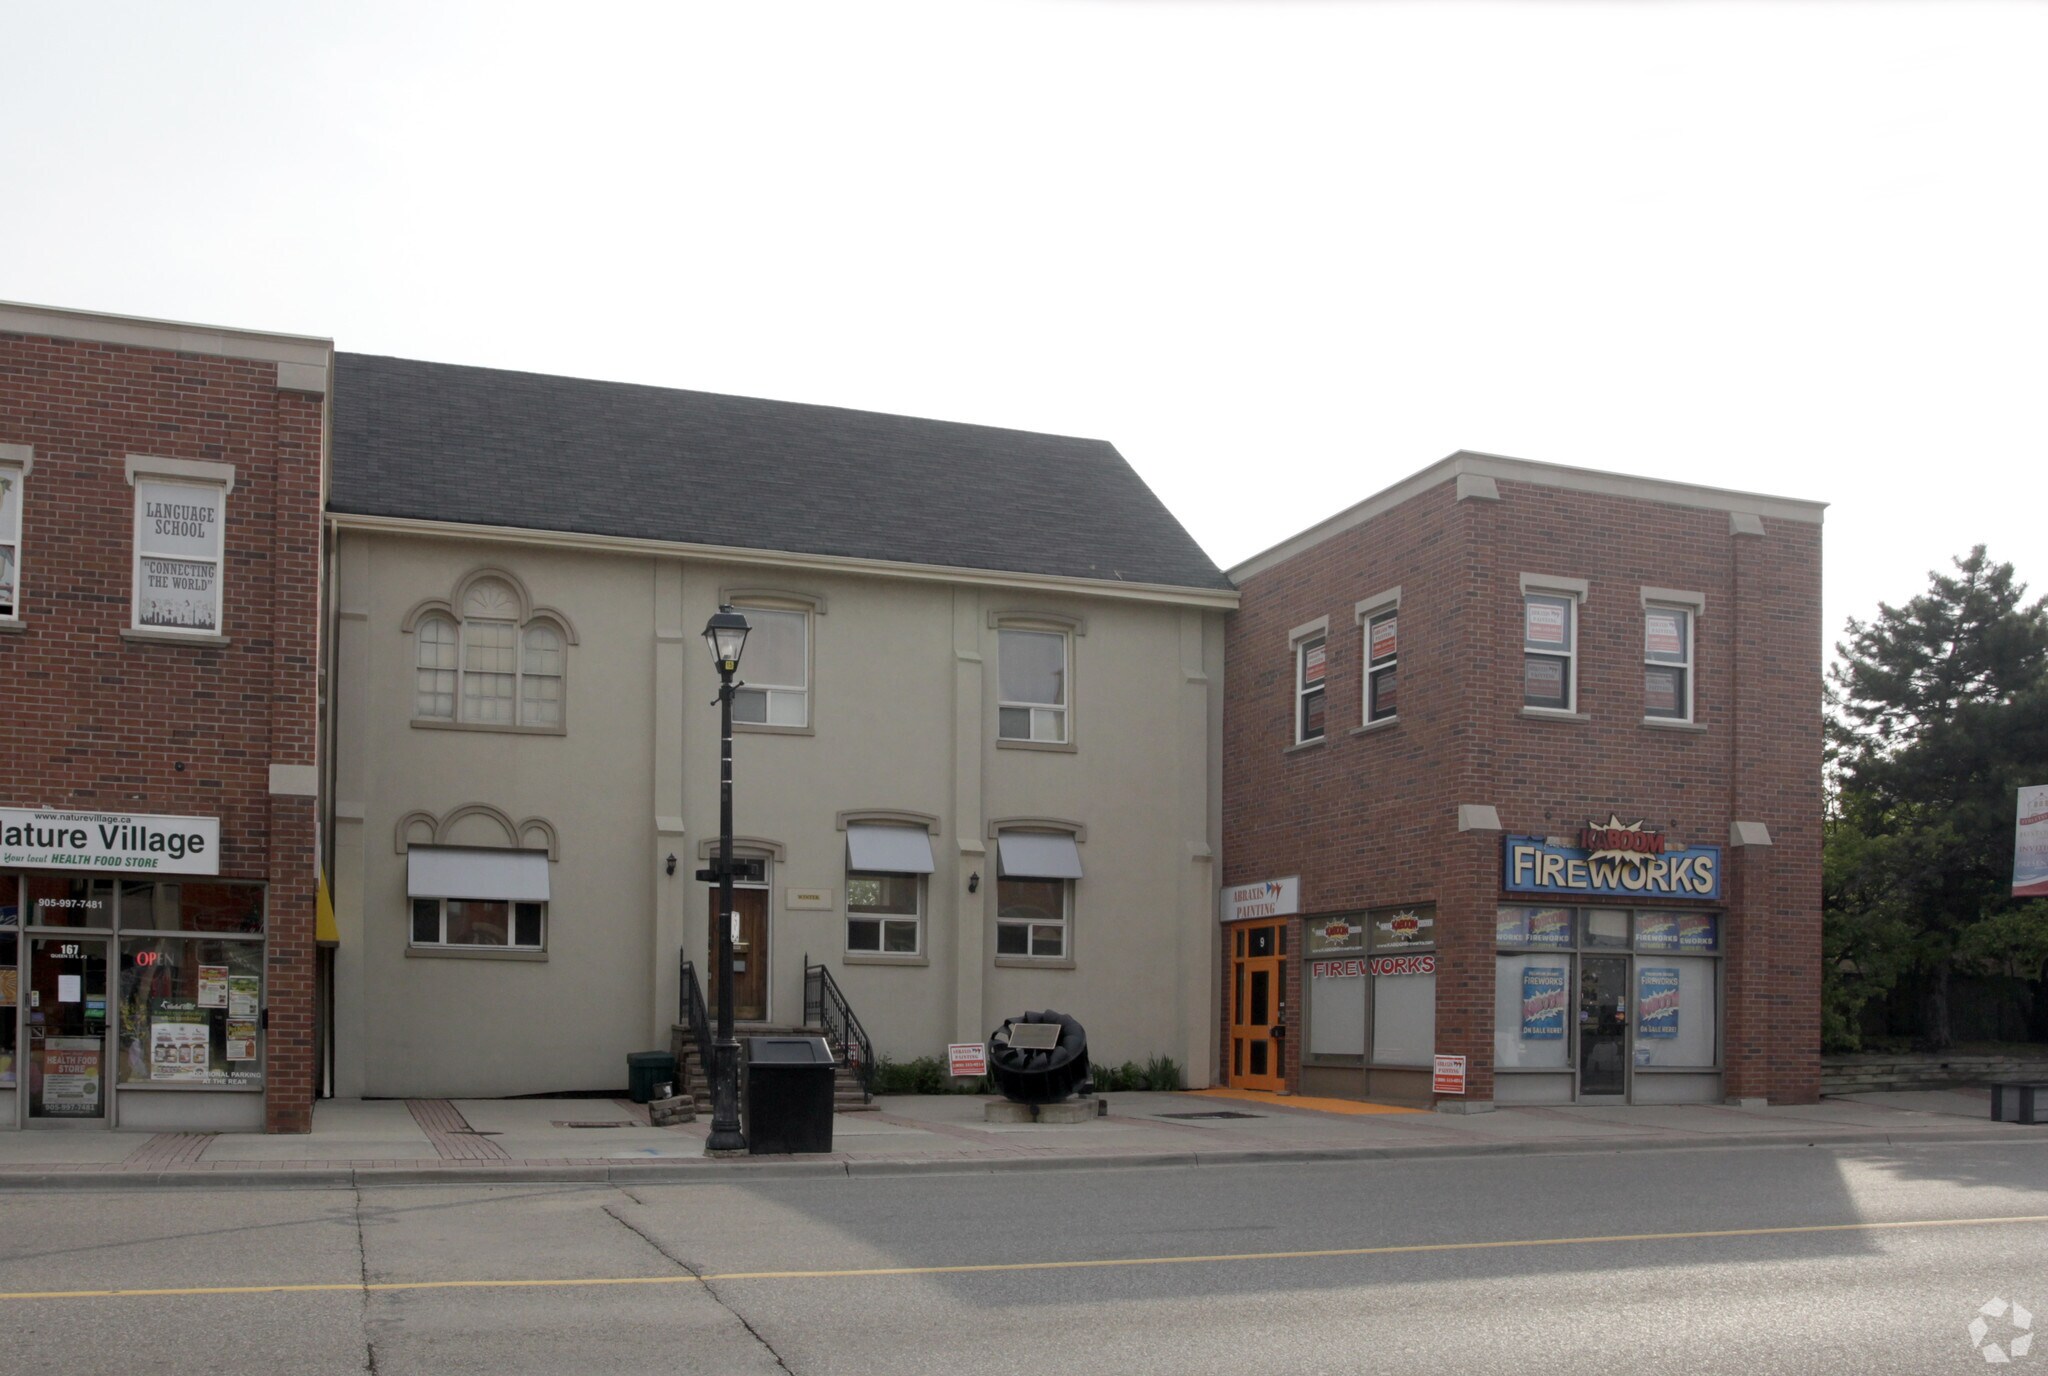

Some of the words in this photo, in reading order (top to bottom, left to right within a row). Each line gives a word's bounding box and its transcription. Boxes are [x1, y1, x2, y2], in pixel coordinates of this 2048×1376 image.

[146, 502, 214, 523] LANGUAGE
[155, 519, 205, 538] SCHOOL
[148, 574, 168, 589] THE
[34, 813, 131, 824] www.naturevillage.ca
[0, 821, 87, 849] ature
[98, 824, 205, 859] Village
[1580, 828, 1665, 854] KABOOM
[4, 853, 24, 863] Your
[27, 854, 47, 863] local
[51, 853, 91, 865] HEALTH
[94, 855, 122, 867] FOOD
[125, 856, 159, 868] STORE
[1514, 845, 1714, 894] FIREWORKS
[1233, 887, 1264, 902] ABRAXIS
[38, 898, 103, 909] 905-997-7481
[1236, 903, 1276, 919] PAINTING
[1260, 937, 1265, 947] 9
[1636, 933, 1678, 942] FIREWORKS
[60, 944, 79, 954] 167
[136, 951, 175, 967] OPEN
[1313, 955, 1436, 978] FIREWORKS
[1524, 976, 1563, 986] FIREWORKS
[1641, 976, 1678, 986] FIREWORKS
[1523, 1026, 1531, 1034] ON
[47, 1055, 75, 1064] HEALTH
[77, 1056, 98, 1064] FOOD
[58, 1065, 86, 1073] STORE
